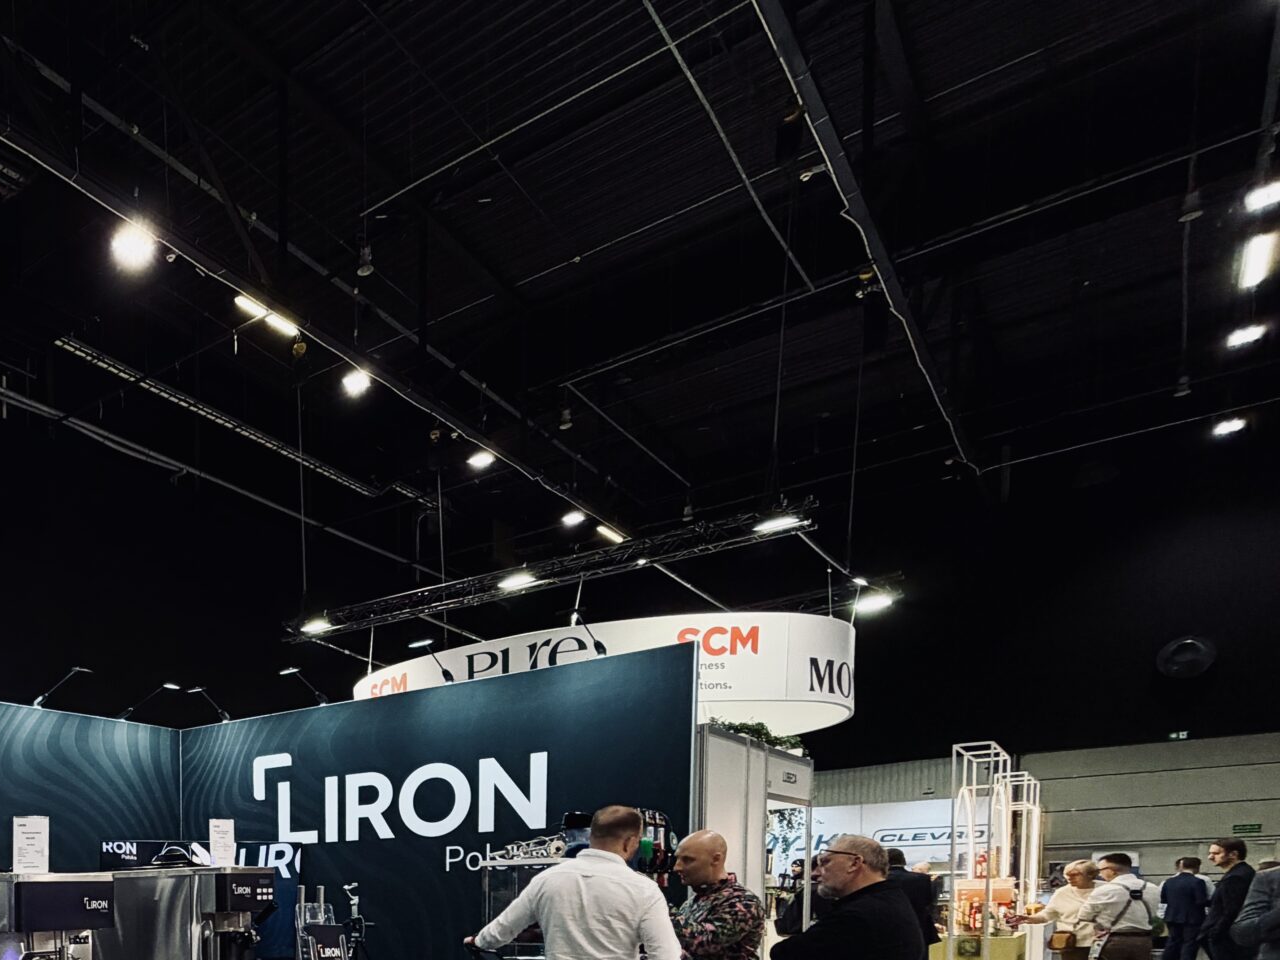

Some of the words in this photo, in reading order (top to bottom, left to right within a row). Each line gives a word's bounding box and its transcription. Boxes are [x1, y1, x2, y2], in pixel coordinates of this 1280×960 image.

[809, 657, 854, 699] MO
[277, 751, 548, 844] LIRON
[234, 886, 251, 895] LIRON
[86, 899, 108, 910] LIRON
[320, 947, 341, 958] LIRON
